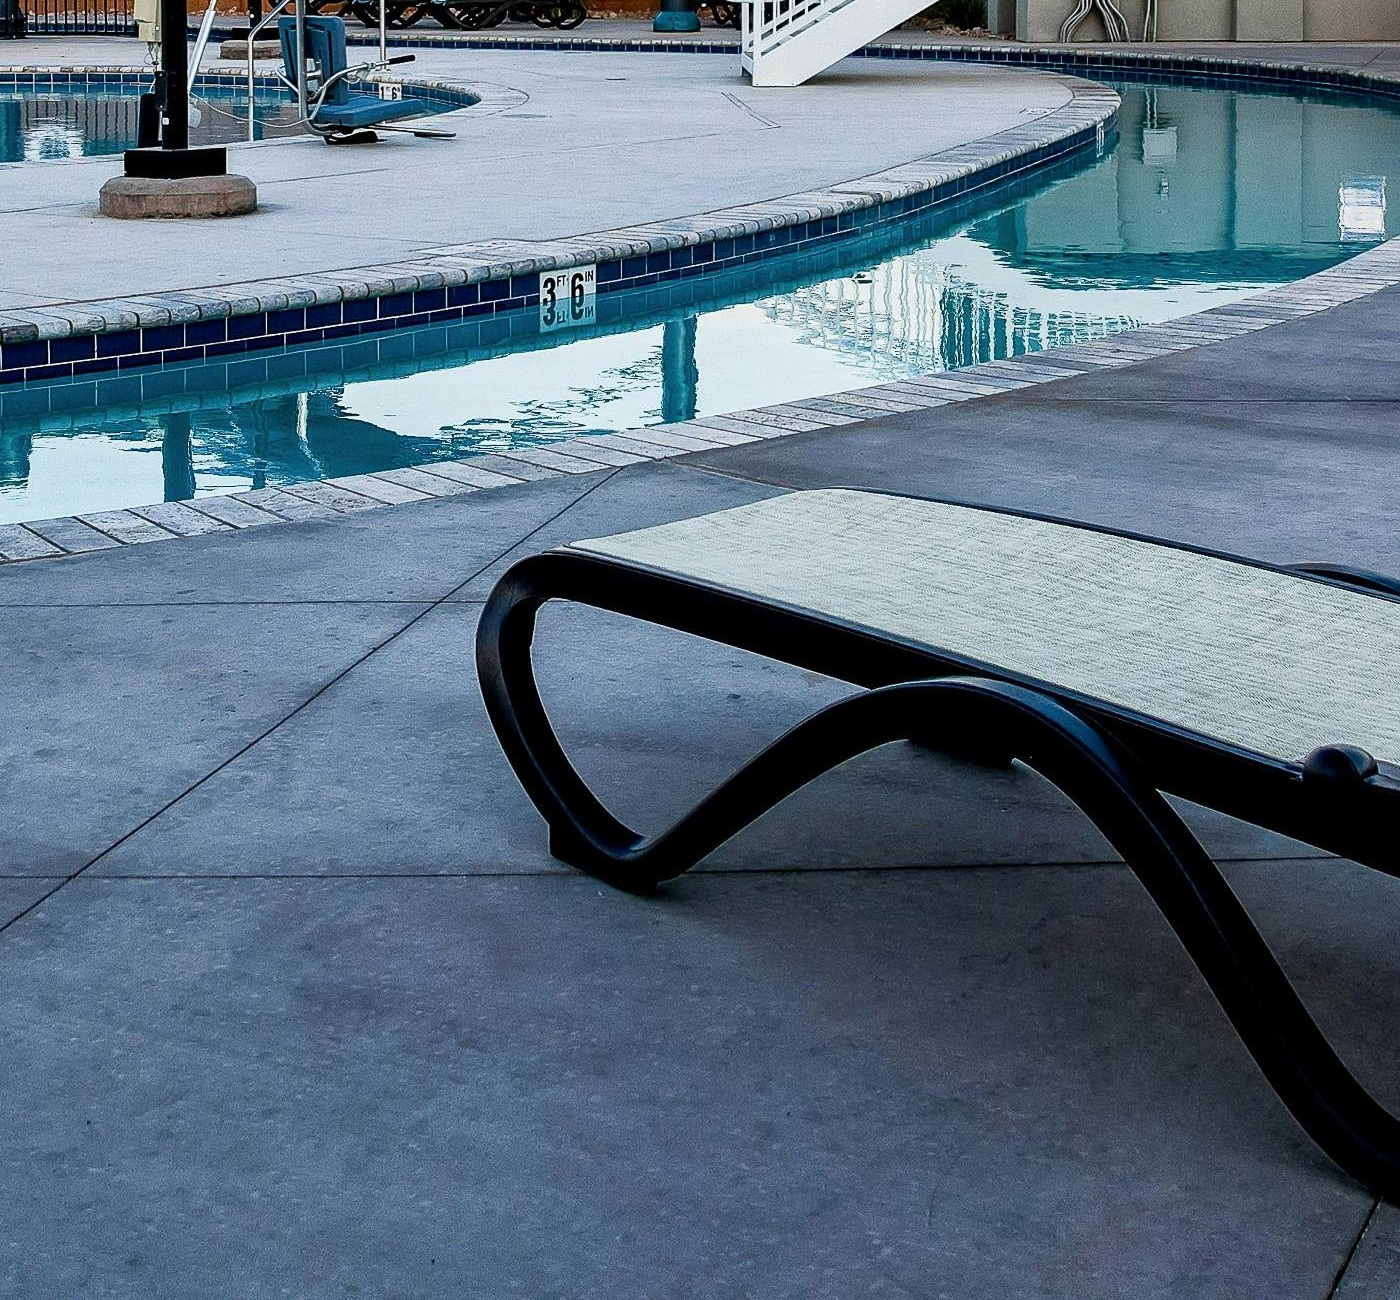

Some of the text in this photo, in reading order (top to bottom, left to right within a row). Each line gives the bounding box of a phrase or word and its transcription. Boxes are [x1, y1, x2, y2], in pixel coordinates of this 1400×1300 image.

[543, 277, 556, 304] 3
[571, 273, 584, 299] 6
[585, 270, 594, 282] IN
